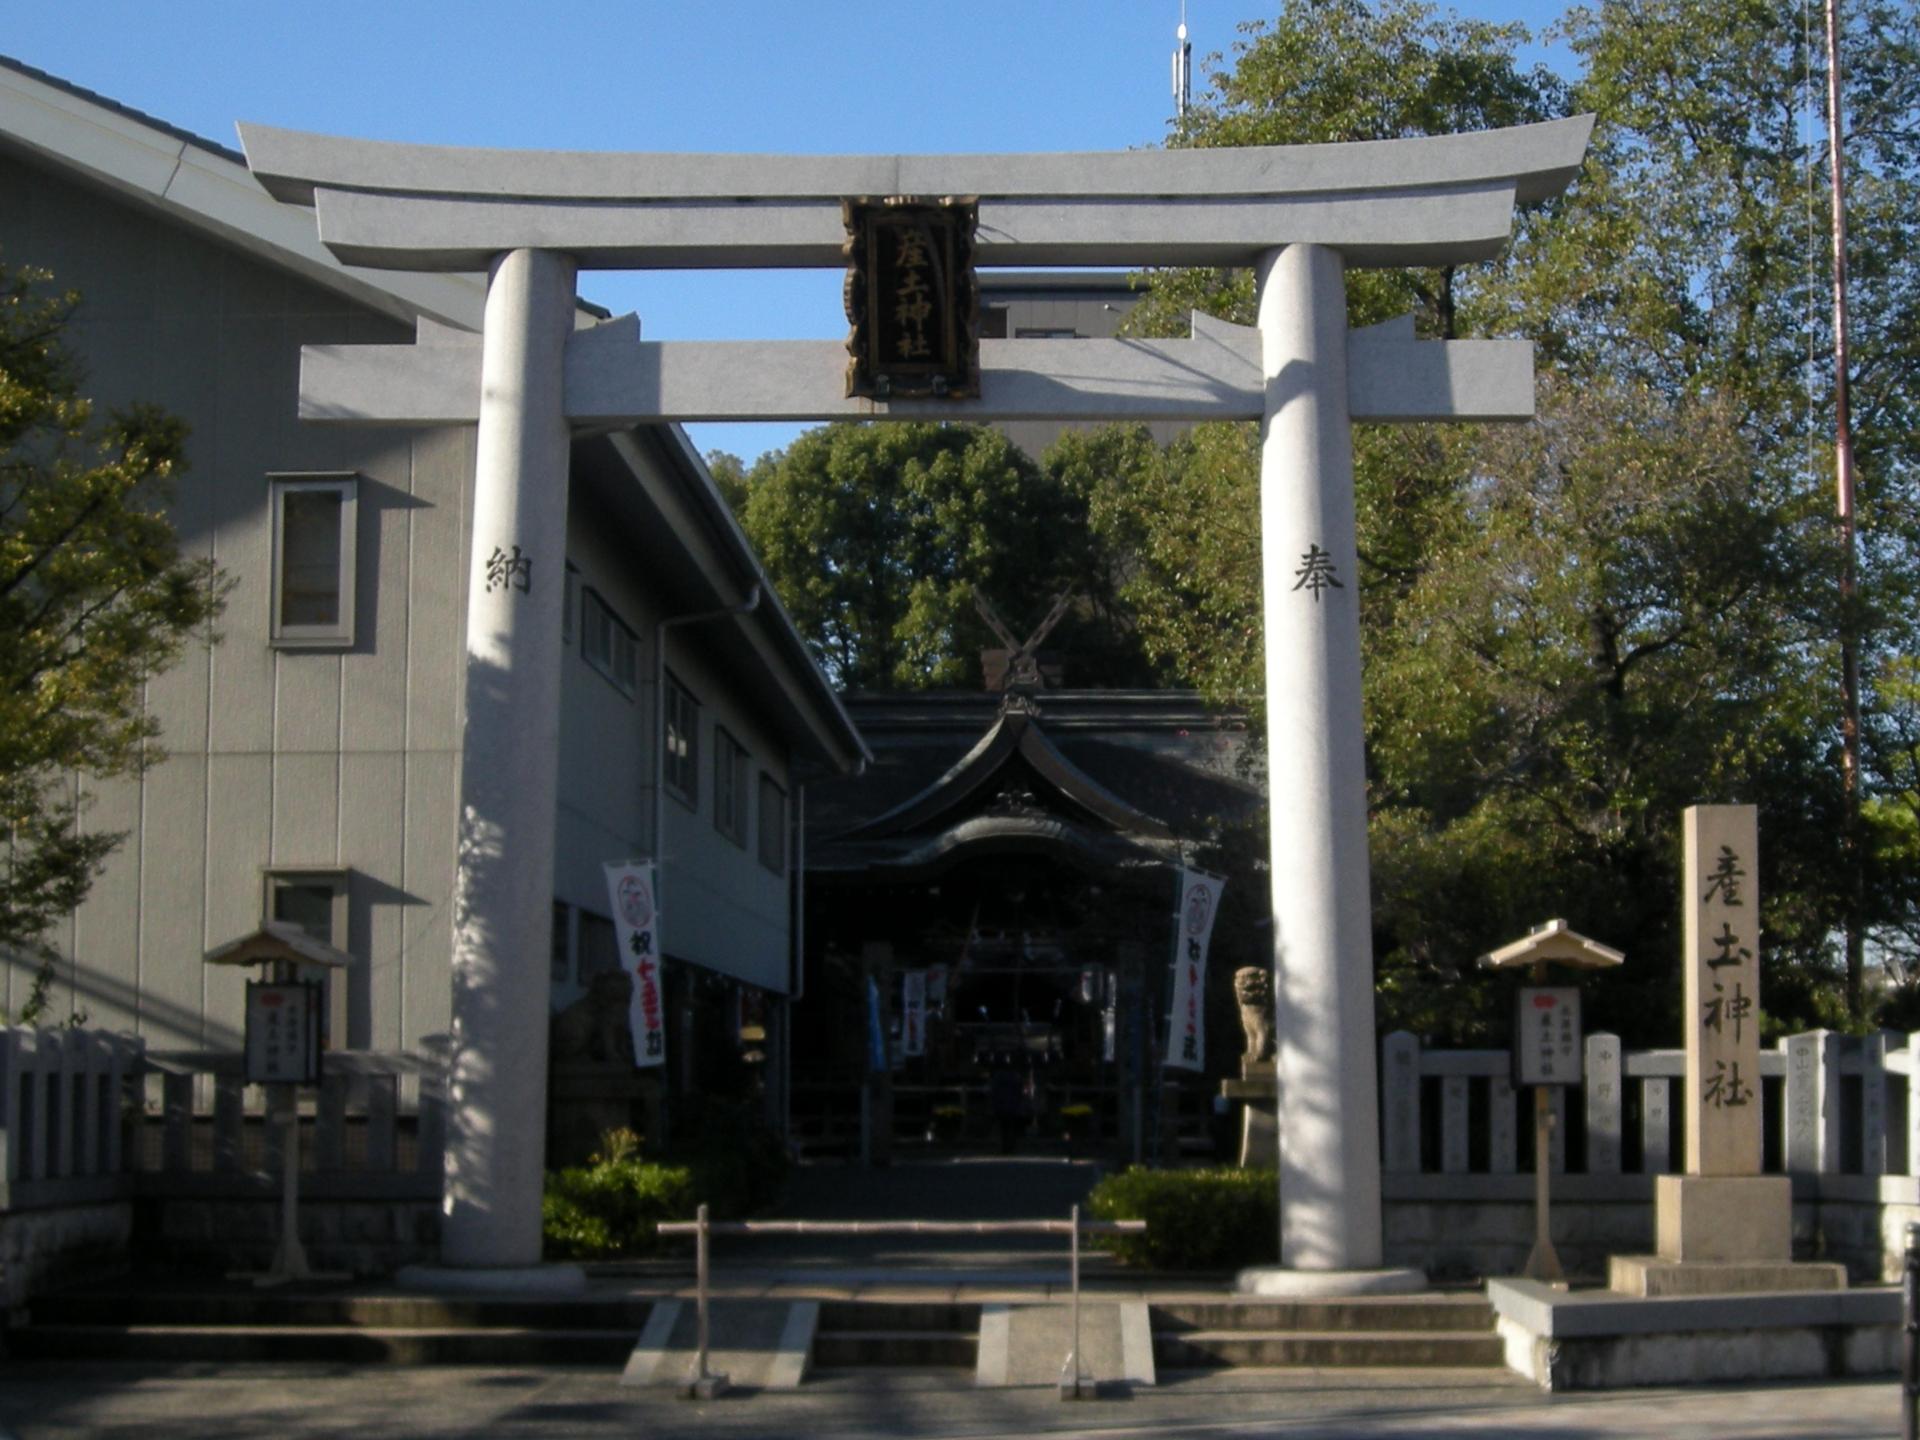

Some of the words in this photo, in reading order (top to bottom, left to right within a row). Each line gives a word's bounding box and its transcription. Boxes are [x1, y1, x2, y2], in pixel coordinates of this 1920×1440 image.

[896, 227, 932, 359] 産土神社
[486, 545, 532, 595] 納
[1292, 543, 1344, 603] 奉
[1704, 845, 1753, 1110] 産土神社
